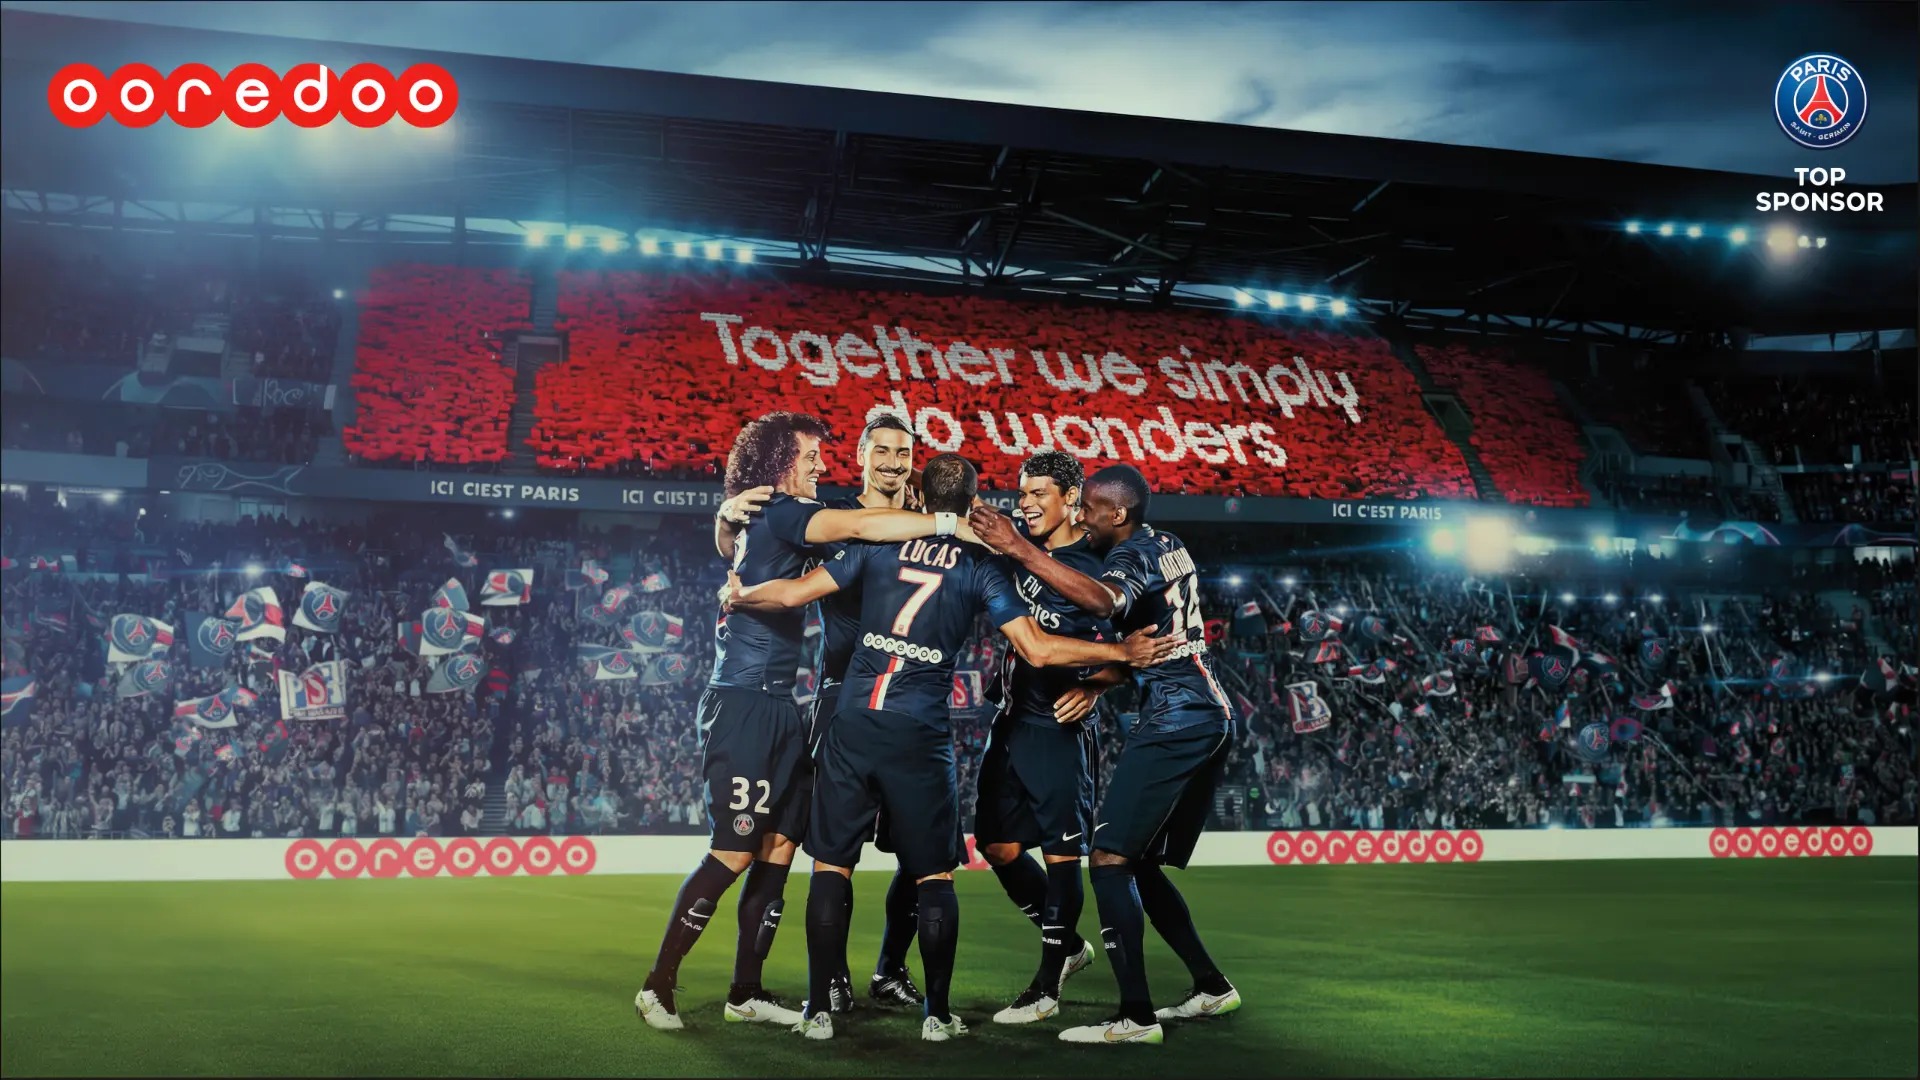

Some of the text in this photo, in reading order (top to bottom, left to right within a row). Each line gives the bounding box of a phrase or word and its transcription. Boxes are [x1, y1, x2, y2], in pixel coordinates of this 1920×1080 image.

[700, 312, 1362, 424] Together we simply
[866, 390, 1288, 468] do wonders
[430, 480, 454, 495] ICI
[520, 484, 580, 502] PARIS
[622, 489, 644, 504] ICI
[1332, 502, 1442, 520] ICI C'EST PARIS
[898, 539, 962, 570] LUCAS
[898, 565, 944, 637] 7
[1022, 574, 1043, 599] Fly
[864, 634, 942, 663] ooredoo
[728, 776, 771, 815] 32
